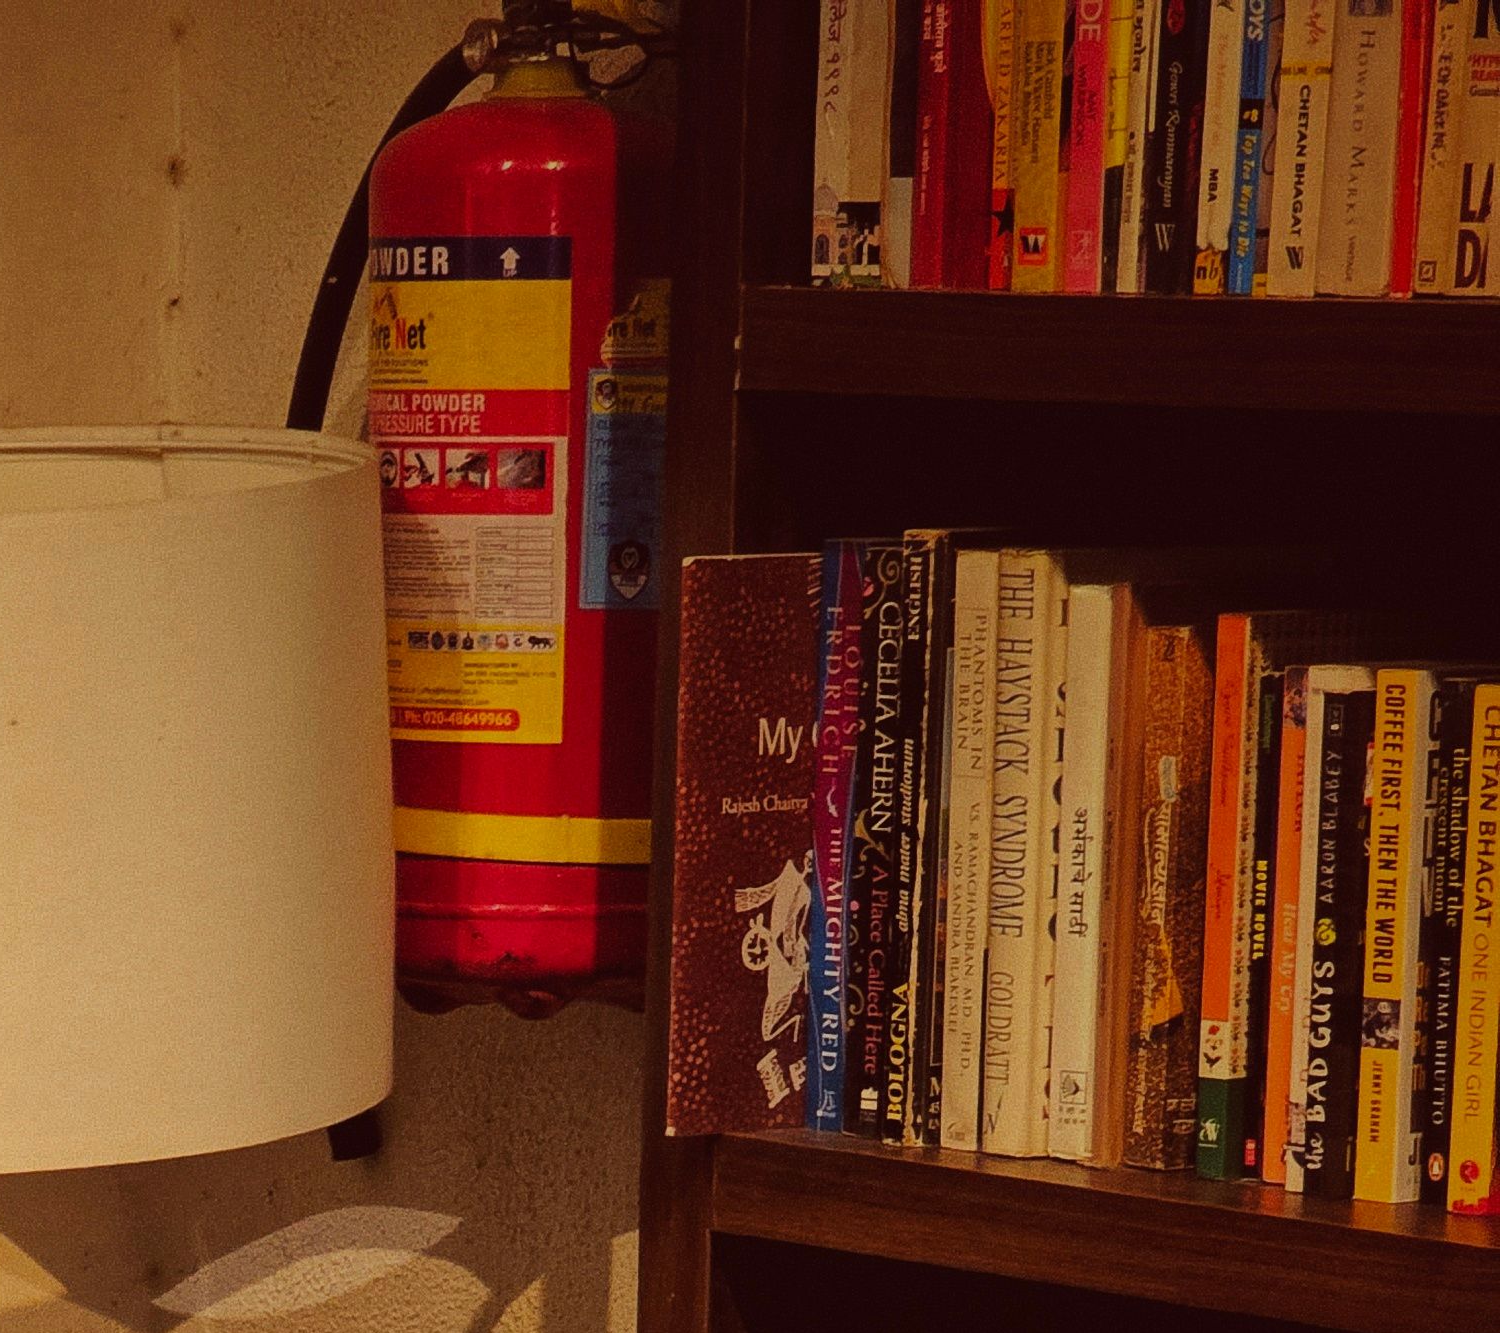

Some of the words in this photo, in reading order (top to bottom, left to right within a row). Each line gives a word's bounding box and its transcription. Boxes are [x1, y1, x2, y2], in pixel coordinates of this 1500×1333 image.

[1296, 83, 1312, 157] CHETAN
[1207, 168, 1220, 204] MBA
[1290, 163, 1306, 236] BHAGAT
[411, 393, 486, 413] POWDER
[437, 414, 481, 434] TYPE
[999, 568, 1036, 622] THE
[821, 606, 843, 774] ERDRICH
[842, 625, 863, 758] LOUISE
[873, 601, 900, 724] CECELIA
[756, 716, 805, 764] My
[990, 637, 1034, 778] HAYSTACK
[1382, 683, 1407, 752] COFFEE
[870, 732, 897, 834] AHERN
[1479, 704, 1500, 813] CHETAN
[829, 826, 842, 868] THE
[987, 794, 1029, 940] SYNDROME
[1377, 824, 1399, 870] THEN
[1474, 819, 1497, 926] BHAGAT
[1253, 859, 1269, 907] MOVIE
[1375, 876, 1397, 911] THE
[821, 877, 842, 1000] MIGHTY
[1252, 913, 1268, 960] NOVEL
[1372, 917, 1396, 984] WORLD
[1472, 932, 1491, 980] ONE
[985, 972, 1017, 1087] GOLDRATT
[1310, 960, 1336, 1049] GUYS
[1467, 989, 1488, 1068] INDIAN
[819, 1012, 840, 1072] RED
[1306, 1057, 1329, 1123] BAD
[1463, 1072, 1483, 1122] GIRL
[1306, 1136, 1326, 1171] the
